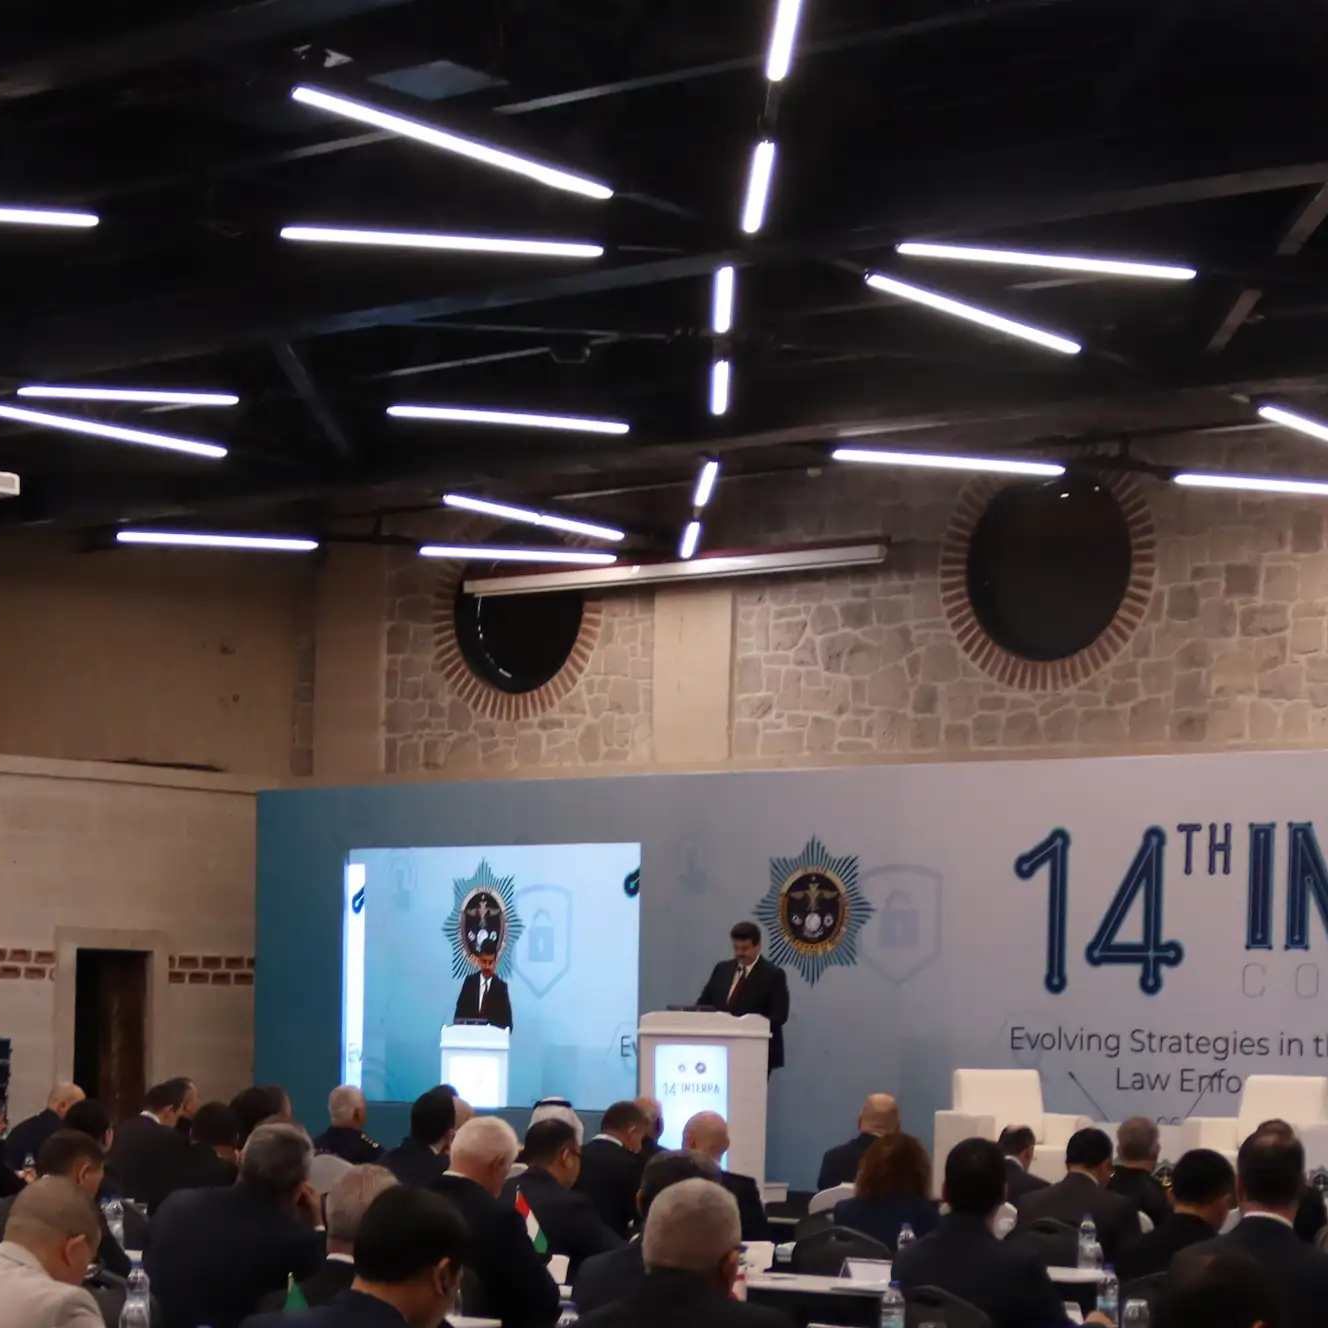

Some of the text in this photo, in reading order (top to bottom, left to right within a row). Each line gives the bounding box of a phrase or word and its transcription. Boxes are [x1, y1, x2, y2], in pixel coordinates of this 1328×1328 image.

[1010, 1024, 1121, 1058] Evolving
[1129, 1028, 1271, 1062] Strategies
[1278, 1033, 1304, 1057] in
[1115, 1066, 1171, 1092] Law
